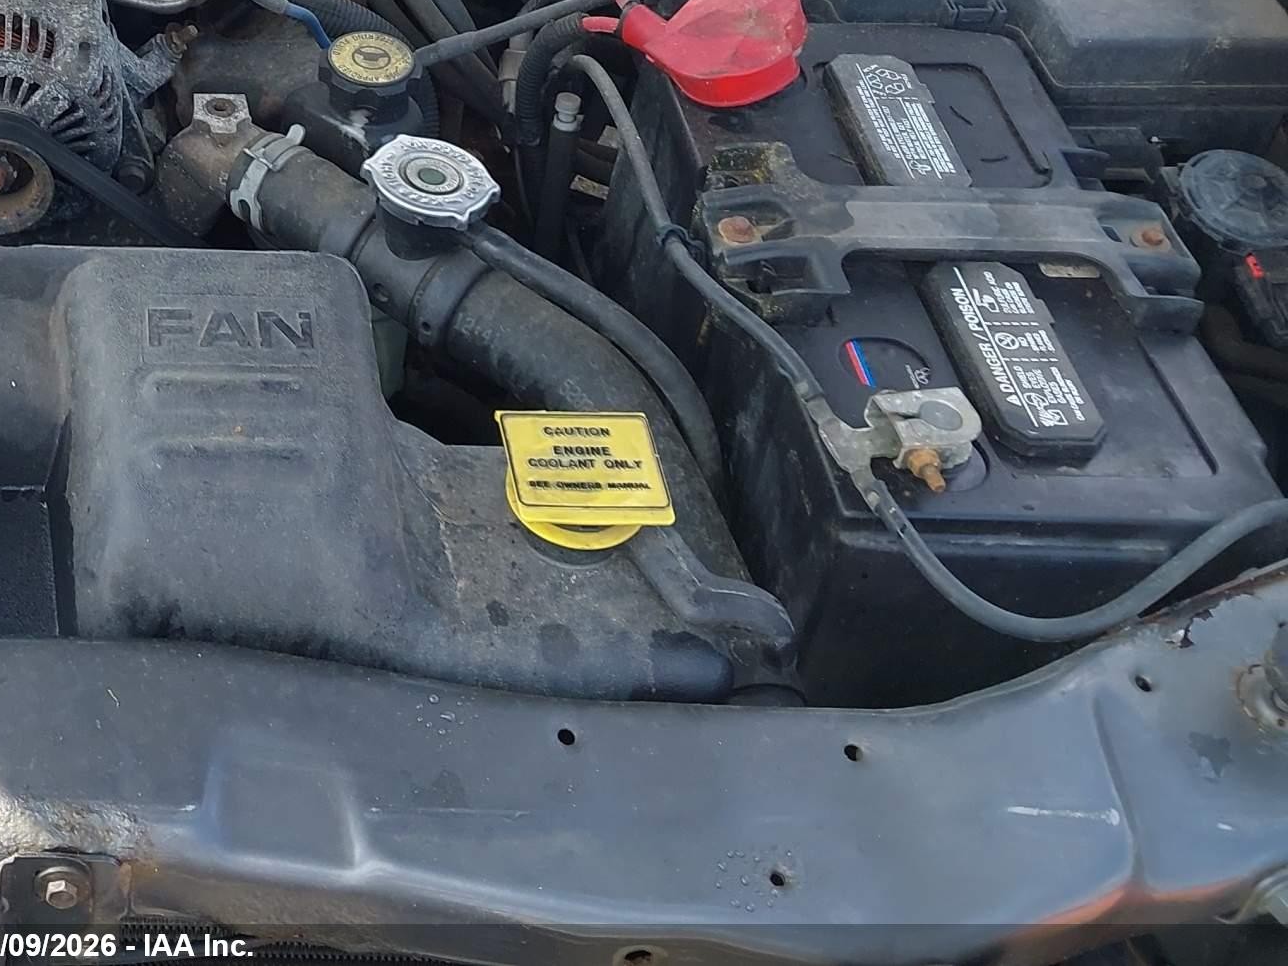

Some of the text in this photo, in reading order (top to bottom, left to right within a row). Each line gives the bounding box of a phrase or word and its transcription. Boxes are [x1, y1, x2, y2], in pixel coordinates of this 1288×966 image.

[950, 287, 983, 331] POISON
[146, 306, 314, 349] FAN
[978, 342, 1016, 393] DANGER
[543, 427, 611, 437] CAUTION
[553, 445, 612, 456] ENGINE
[528, 458, 643, 470] COOLANT ONLY
[528, 480, 550, 489] SEE
[607, 482, 652, 490] MANUAL
